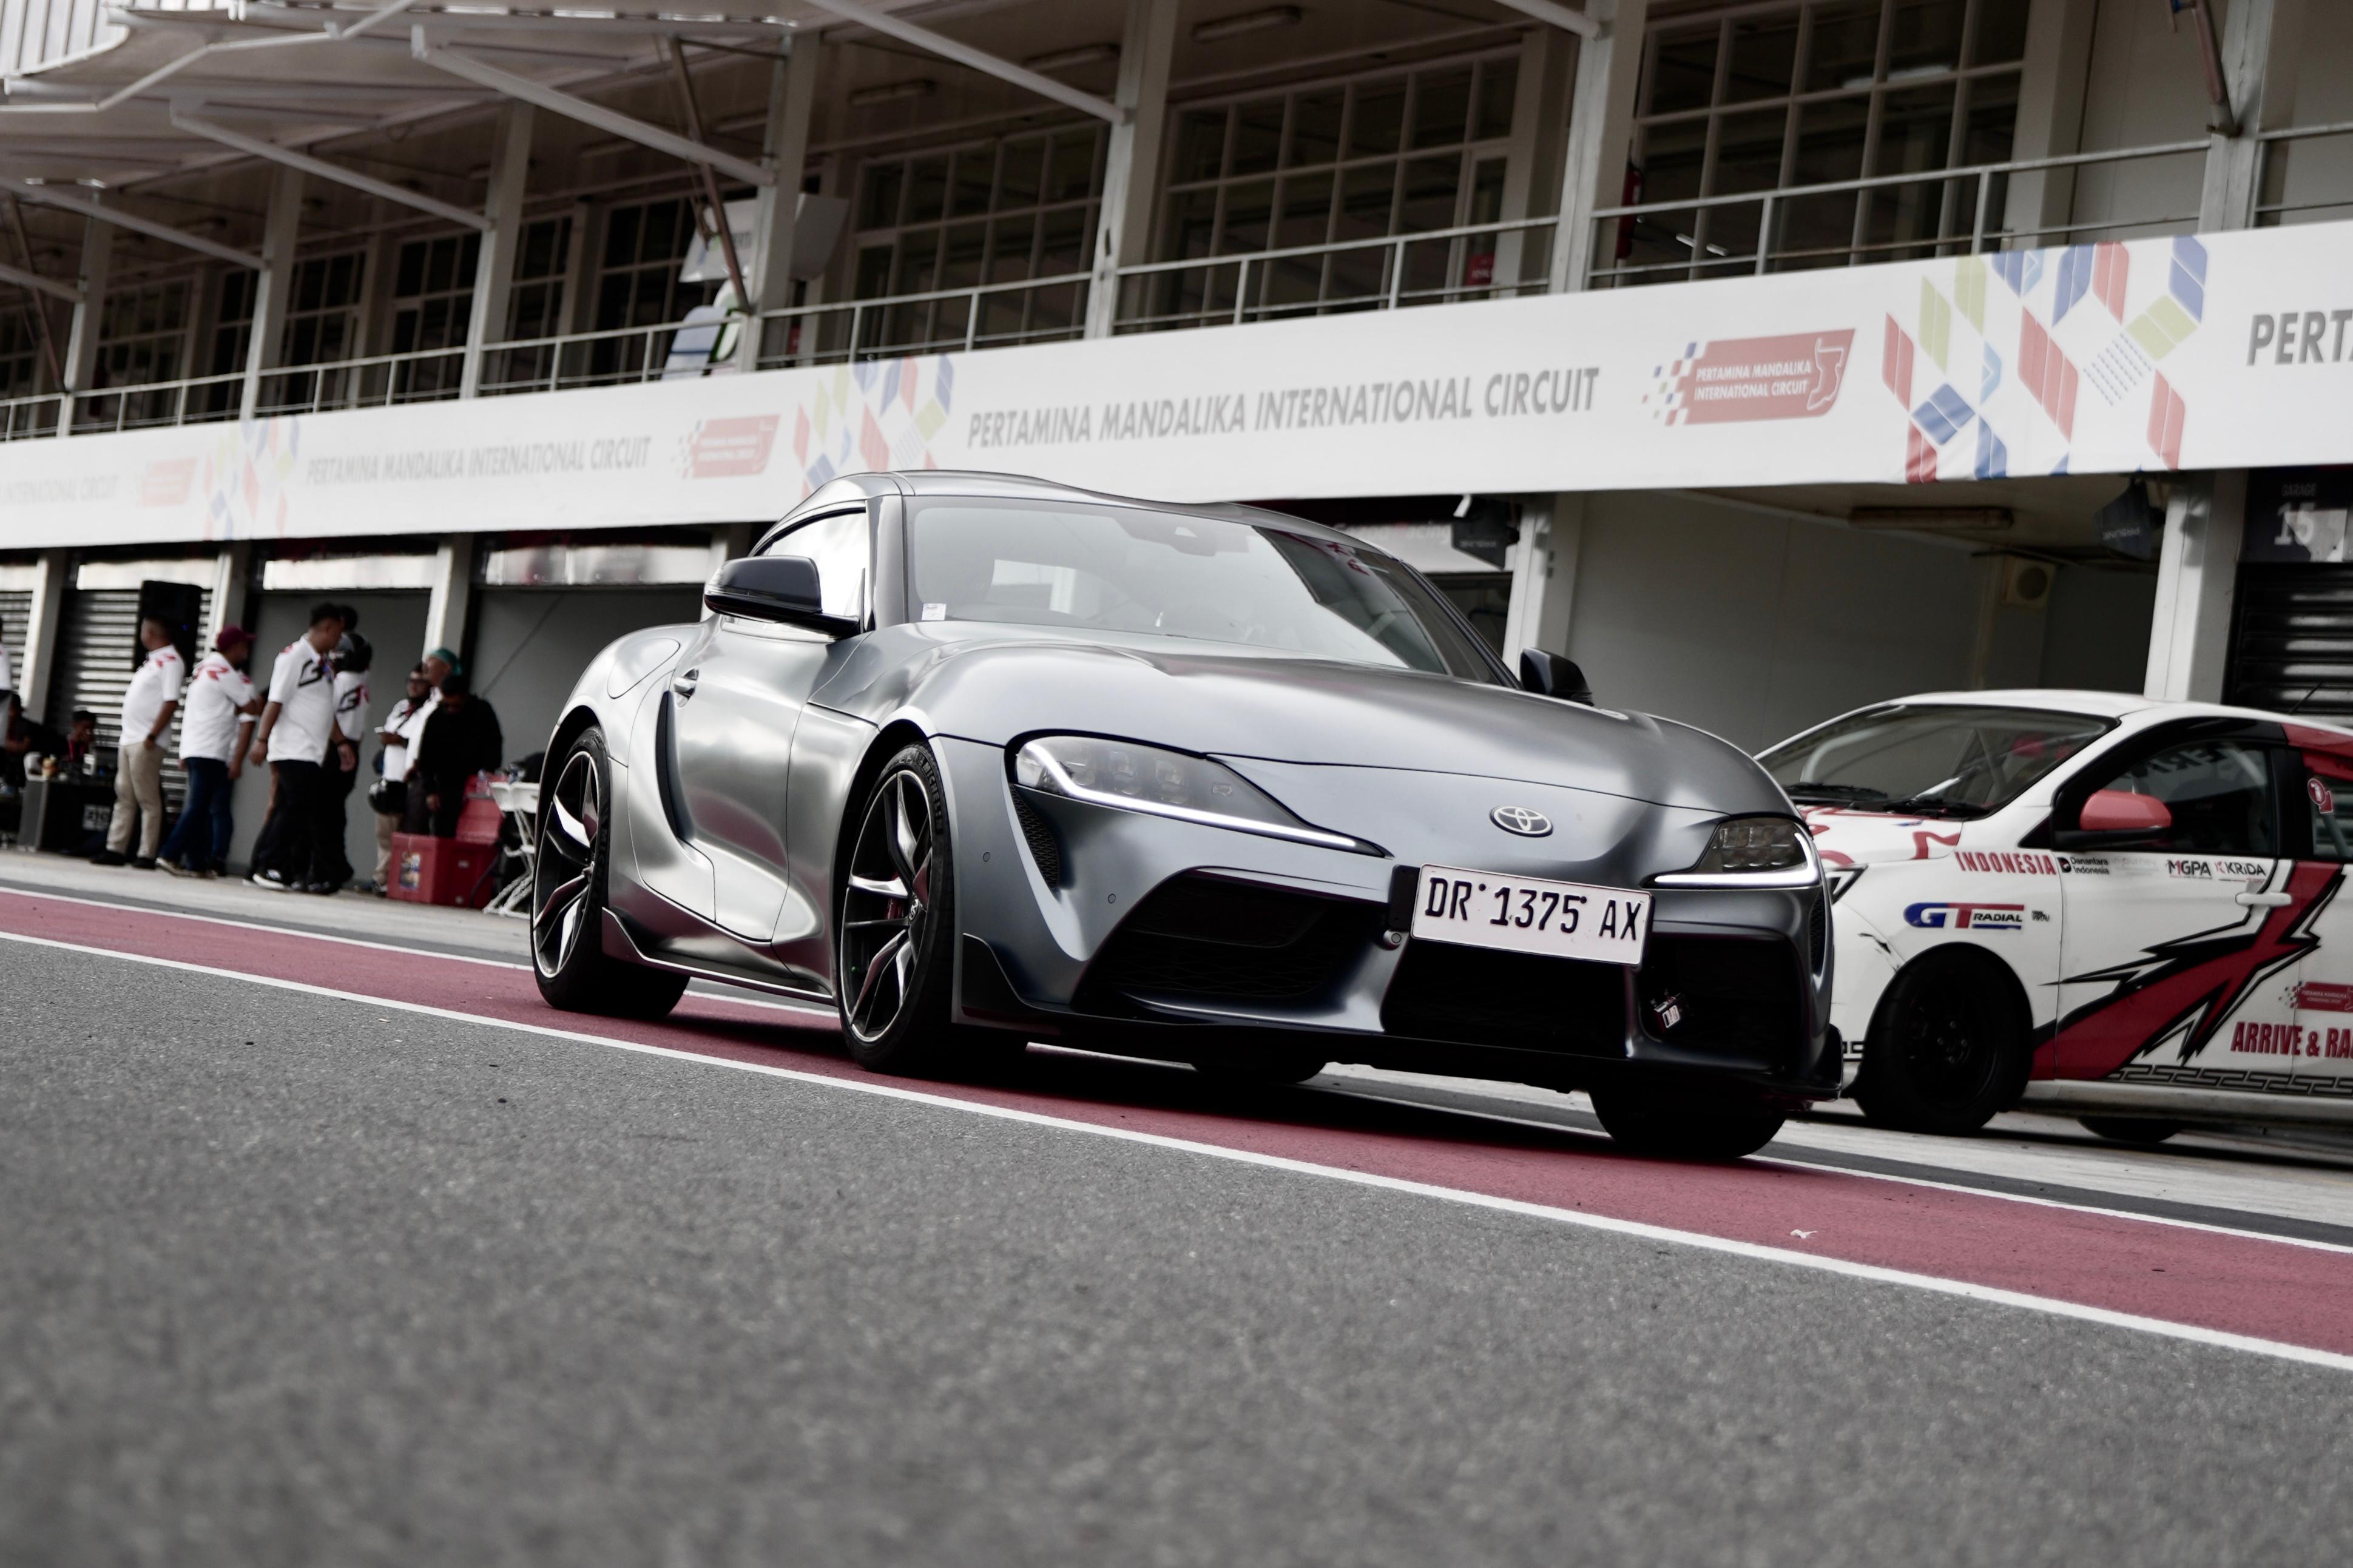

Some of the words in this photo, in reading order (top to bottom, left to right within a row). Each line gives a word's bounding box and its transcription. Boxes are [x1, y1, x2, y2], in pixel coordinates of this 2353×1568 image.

[1696, 365, 1749, 382] PERTAMINA
[1752, 359, 1811, 378] MANDALIKA
[1694, 383, 1768, 400] INTERNATIONAL
[1771, 380, 1809, 395] CIRCUIT
[968, 405, 1092, 449] PERTAMINA
[1099, 394, 1246, 442] MANDALIKA
[1254, 377, 1473, 432] INTERNATIONAL
[1484, 368, 1600, 417] CIRCUIT
[306, 456, 378, 485] PERTAMINA
[382, 448, 464, 482] MANDALIKA
[467, 440, 584, 479] INTERNATIONAL
[590, 436, 652, 471] CIRCUIT
[2282, 483, 2318, 497] GARAGE
[1954, 852, 2056, 875] INDONESIA
[2070, 856, 2108, 865] Danantara
[2073, 866, 2109, 874] Indonesia
[2167, 860, 2212, 876] MGPA
[1425, 877, 1472, 921] DR
[1490, 887, 1580, 934] 1375
[1599, 899, 1641, 941] AX
[1903, 903, 2024, 929] GT
[1973, 913, 2022, 923] RADIAL
[2230, 1022, 2303, 1056] ARRIVE
[2306, 1031, 2320, 1057] &
[2324, 1028, 2353, 1059] RA
